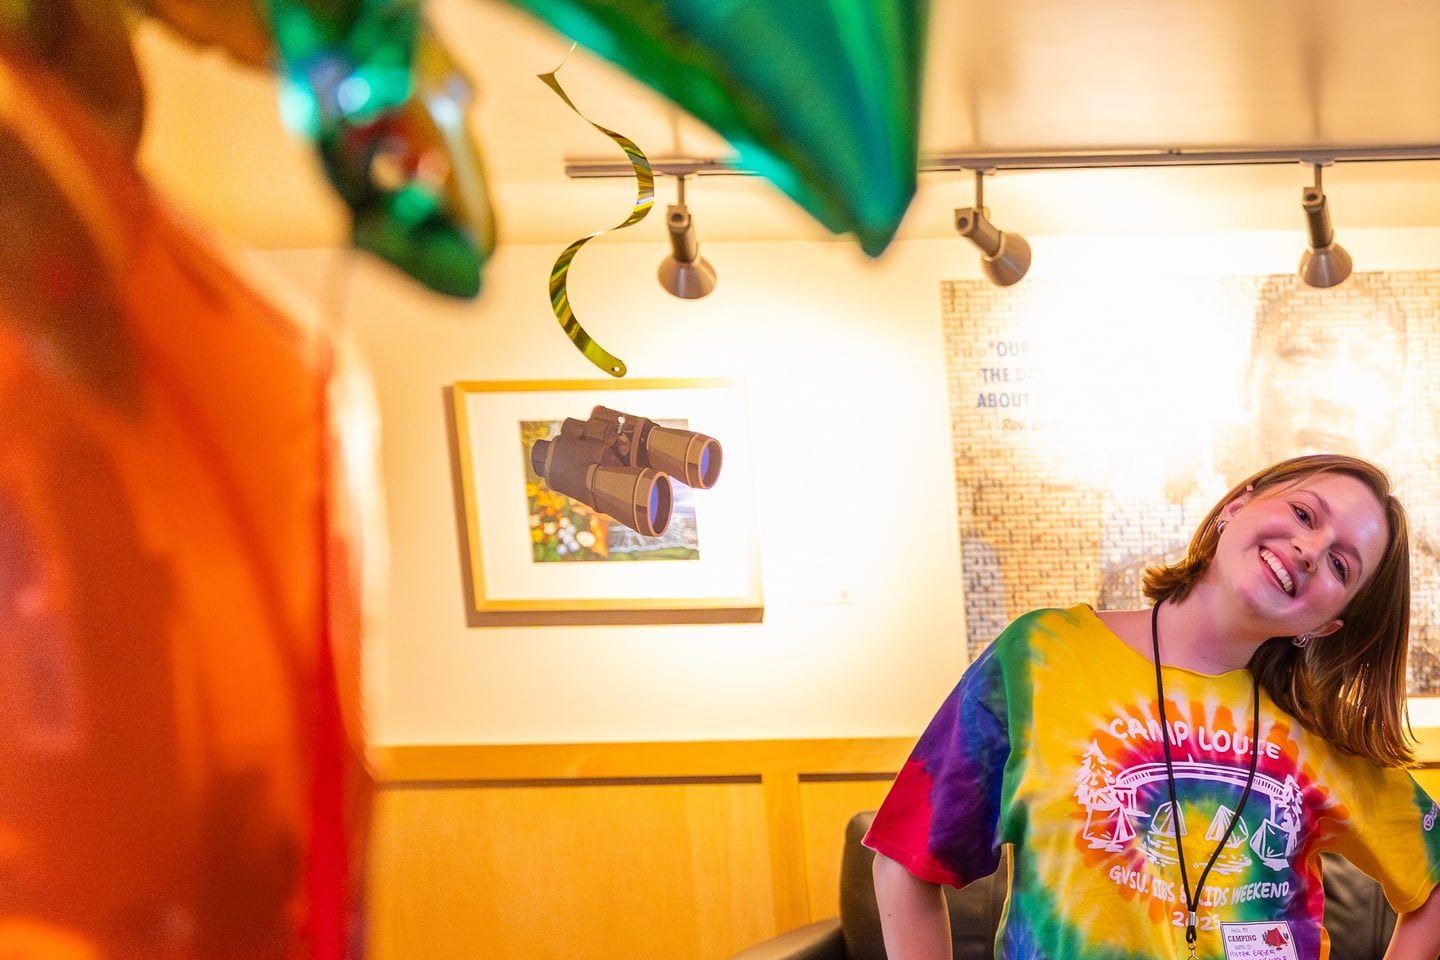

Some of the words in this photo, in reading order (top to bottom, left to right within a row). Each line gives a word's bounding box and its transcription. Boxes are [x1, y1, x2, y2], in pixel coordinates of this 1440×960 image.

[981, 367, 1010, 384] THE
[976, 392, 1030, 408] ABOUT
[1109, 718, 1189, 748] CAMP
[1198, 726, 1282, 760] LOUIE
[1109, 865, 1149, 894] GVSU.
[1152, 879, 1175, 903] SIBS
[1230, 881, 1290, 905] WEEKEND
[1227, 934, 1257, 943] CAMPING
